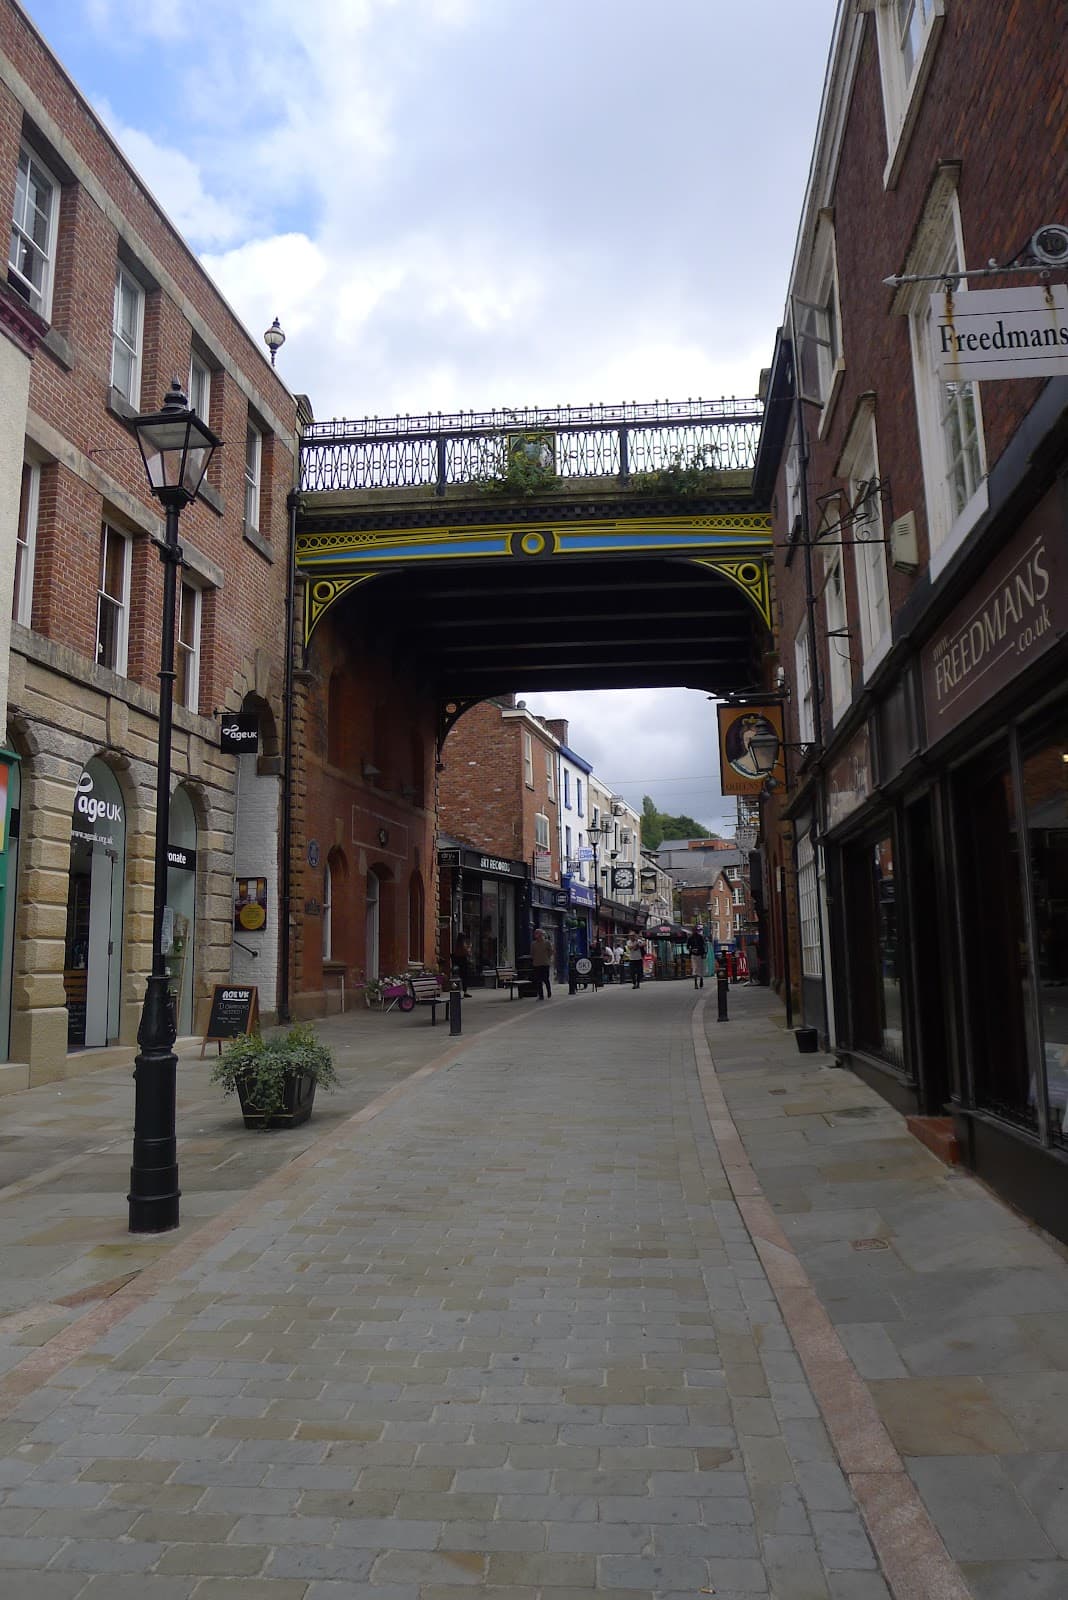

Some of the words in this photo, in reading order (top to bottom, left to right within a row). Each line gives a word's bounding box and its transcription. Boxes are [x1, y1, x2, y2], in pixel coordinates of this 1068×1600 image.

[937, 320, 1068, 353] Freedmans
[934, 545, 1049, 700] FREEDMANS
[167, 852, 187, 864] onate
